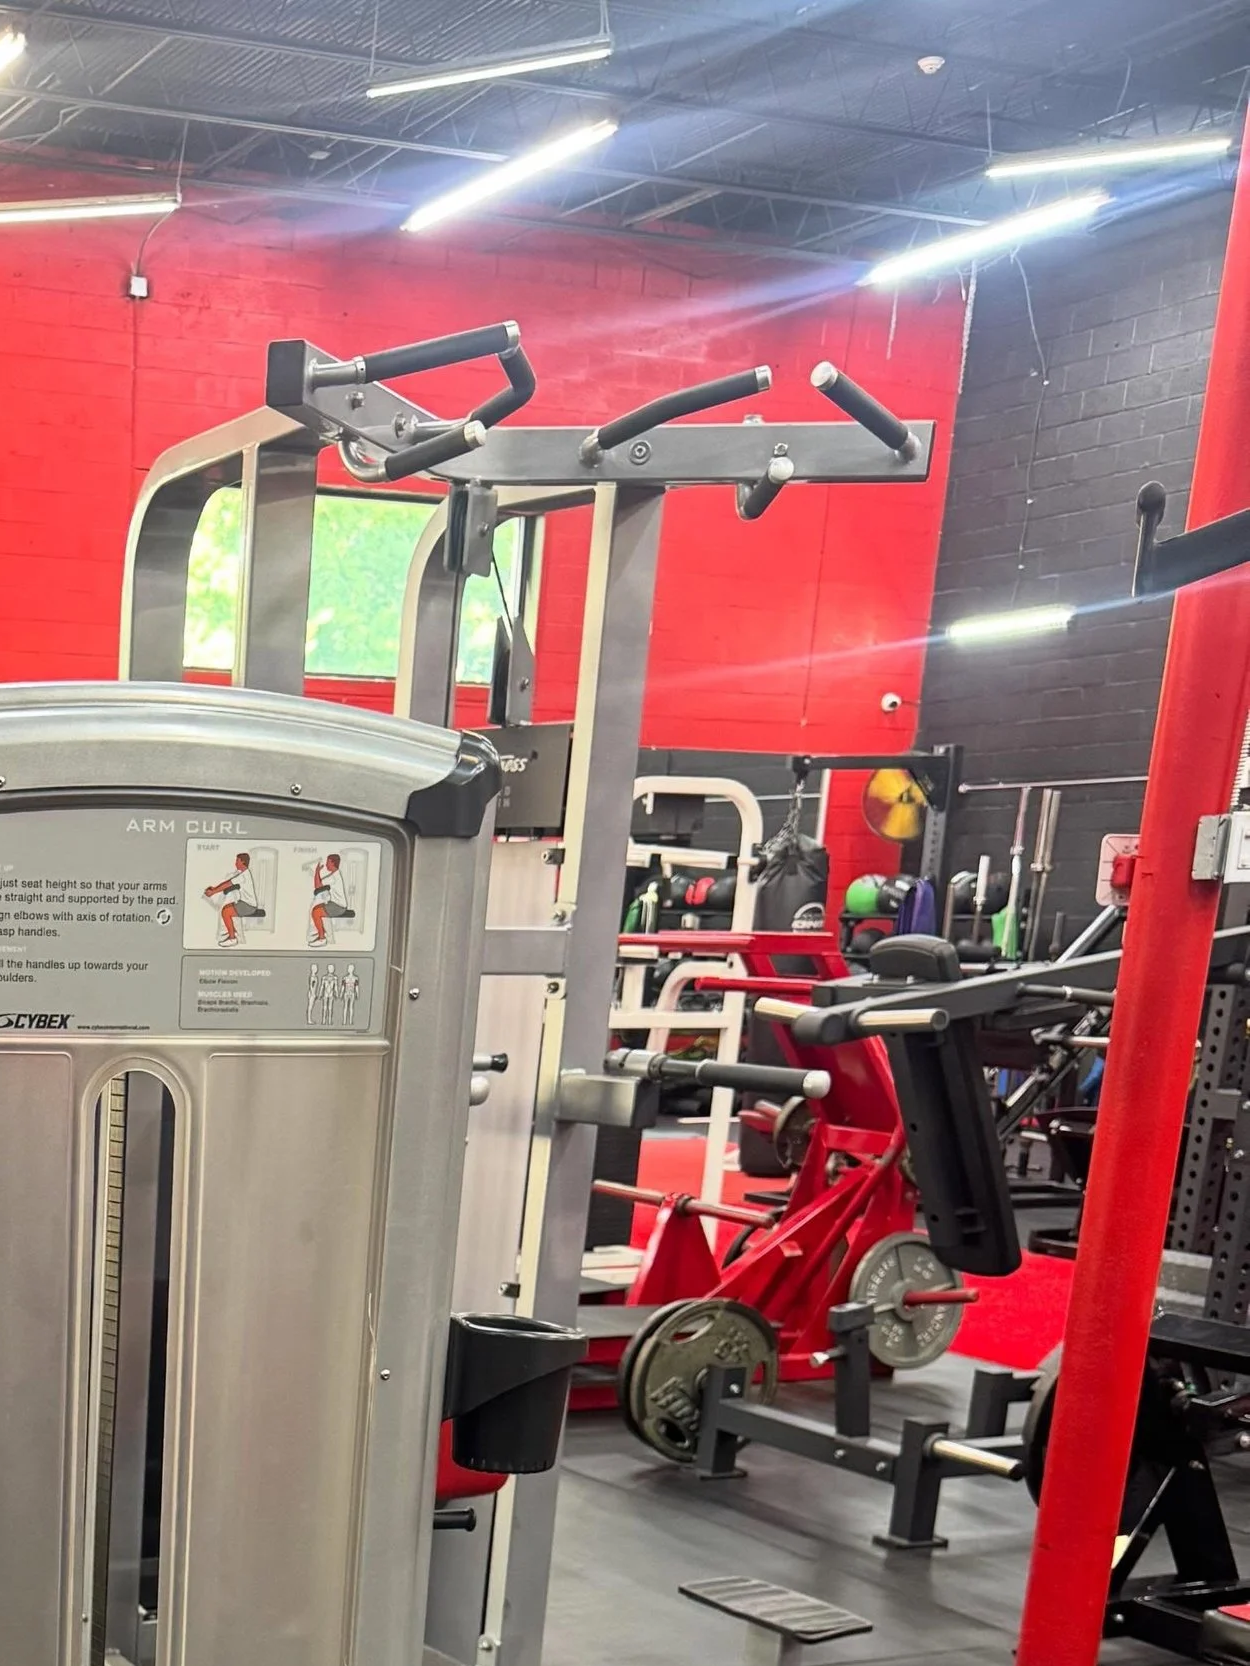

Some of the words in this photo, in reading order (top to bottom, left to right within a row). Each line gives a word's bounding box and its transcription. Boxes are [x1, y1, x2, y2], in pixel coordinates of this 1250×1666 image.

[126, 819, 175, 833] ARM
[186, 820, 248, 834] CURL
[21, 879, 42, 888] seat
[45, 879, 77, 891] height
[80, 881, 92, 889] so
[95, 880, 115, 890] that
[118, 882, 140, 892] your
[143, 882, 168, 891] arms
[4, 893, 43, 904] straight
[46, 893, 65, 903] and
[68, 894, 119, 905] supported
[122, 894, 135, 906] by
[137, 895, 154, 904] the
[156, 896, 178, 906] pad.
[13, 910, 49, 920] elbows
[52, 911, 73, 921] with
[76, 912, 97, 921] axis
[99, 912, 110, 921] of
[112, 913, 154, 922] rotation.
[18, 926, 60, 937] handles.
[7, 959, 23, 969] the
[25, 959, 65, 969] handles
[68, 961, 81, 971] up
[84, 961, 124, 970] towards
[126, 962, 148, 972] your
[13, 1013, 71, 1029] CYBEX
